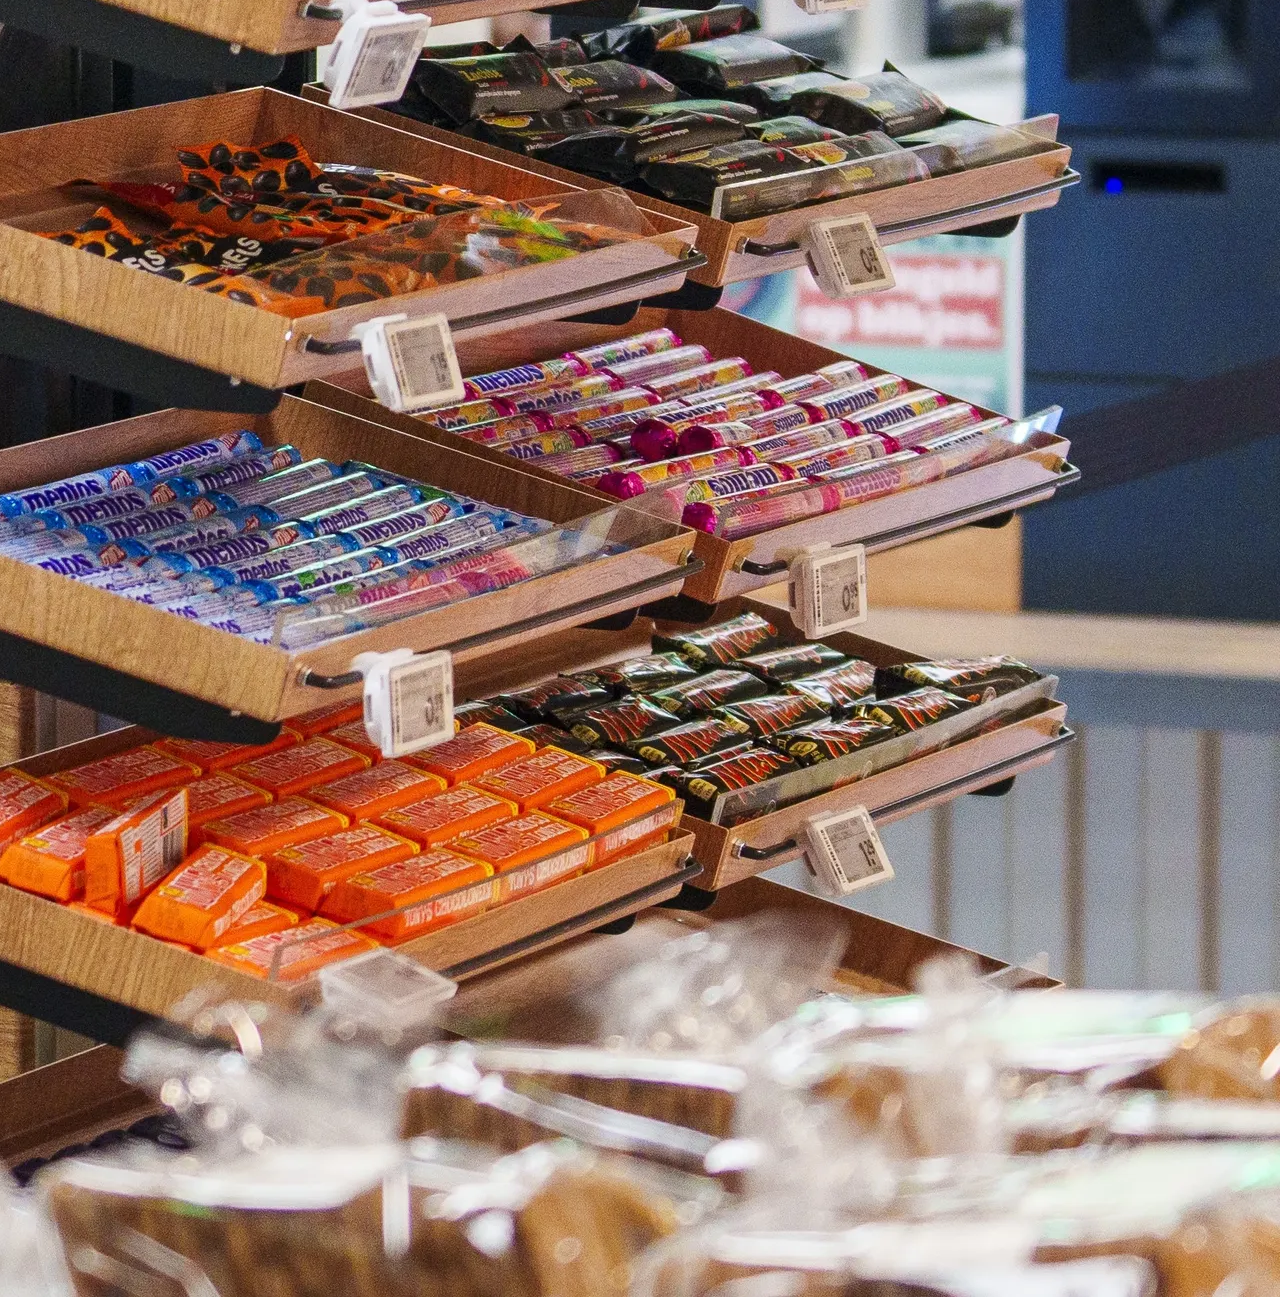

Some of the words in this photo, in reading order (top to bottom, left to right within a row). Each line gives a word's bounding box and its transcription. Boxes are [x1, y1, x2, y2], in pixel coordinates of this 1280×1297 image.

[474, 364, 545, 392] mentos
[824, 389, 878, 419] mentos
[862, 404, 915, 433] mentos
[149, 441, 221, 471] mentos
[797, 458, 830, 478] mentos
[202, 460, 268, 490] mentos
[22, 479, 102, 512] mentos
[65, 492, 145, 525] mentos
[106, 506, 188, 540] mentos
[320, 506, 369, 535] mentos
[357, 512, 427, 543] mentos
[192, 534, 270, 568] mentos
[400, 531, 450, 559] mentos
[238, 556, 291, 581] mentos
